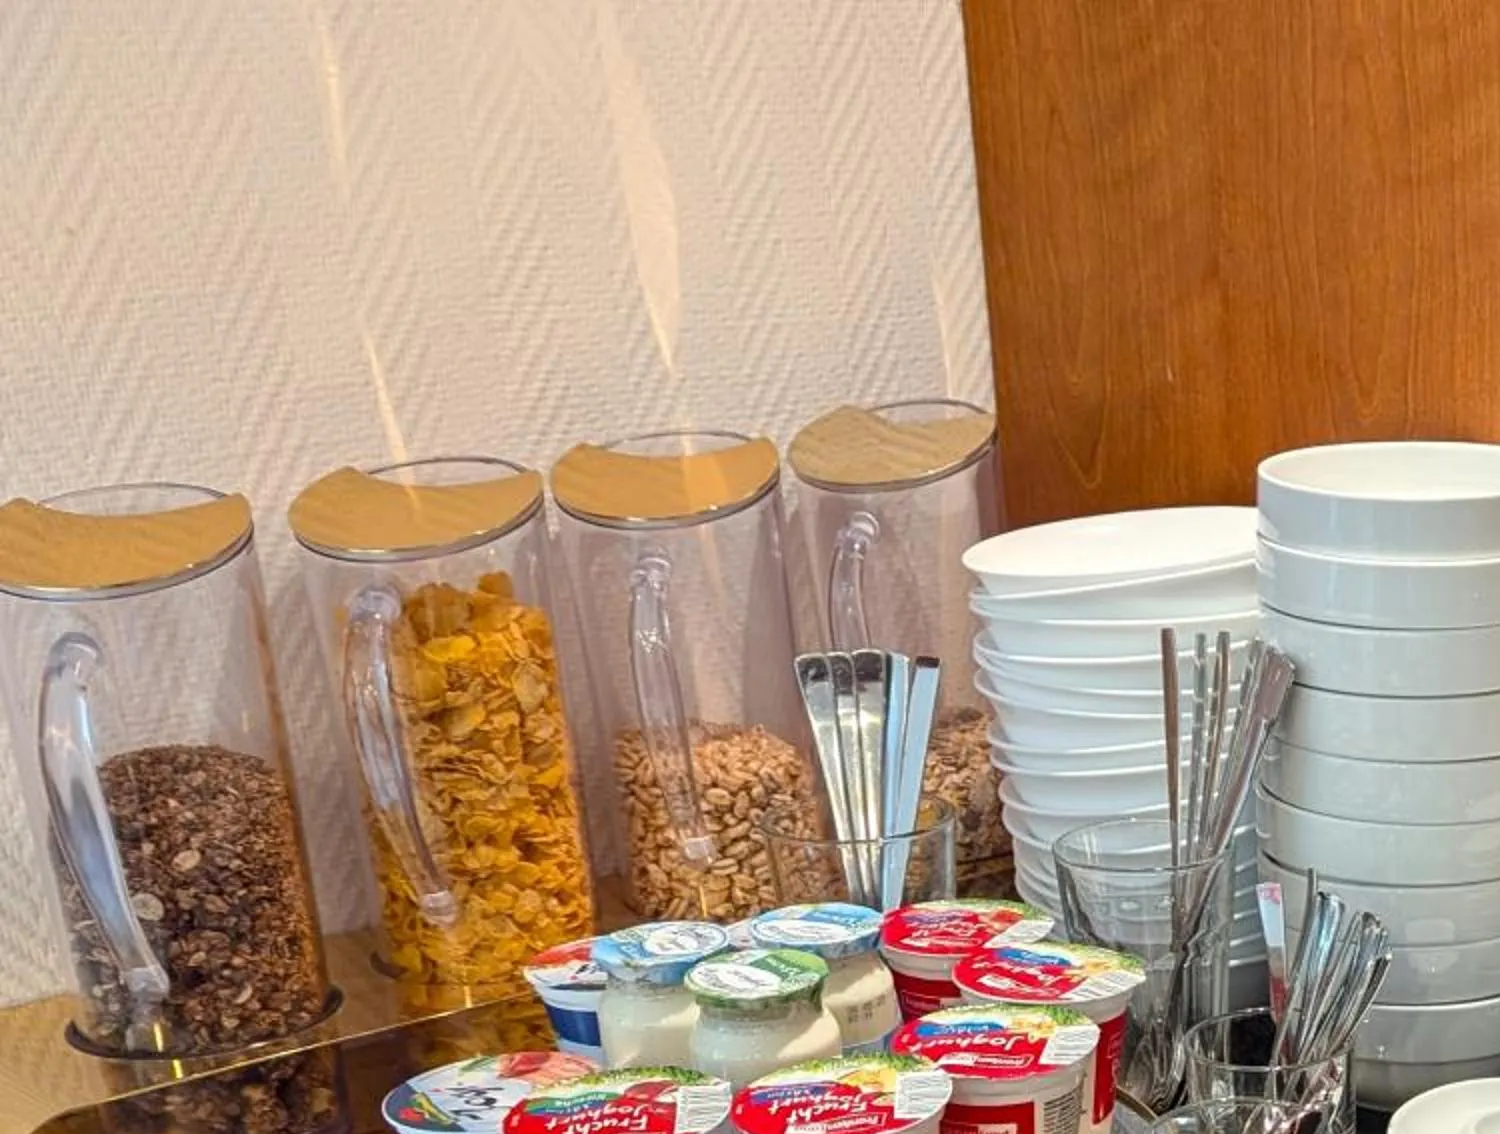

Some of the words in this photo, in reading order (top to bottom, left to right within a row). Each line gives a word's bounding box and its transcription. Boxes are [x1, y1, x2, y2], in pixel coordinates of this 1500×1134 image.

[767, 1090, 863, 1114] Joghurt
[785, 1100, 869, 1125] Frucht
[544, 1103, 647, 1133] Joghurt
